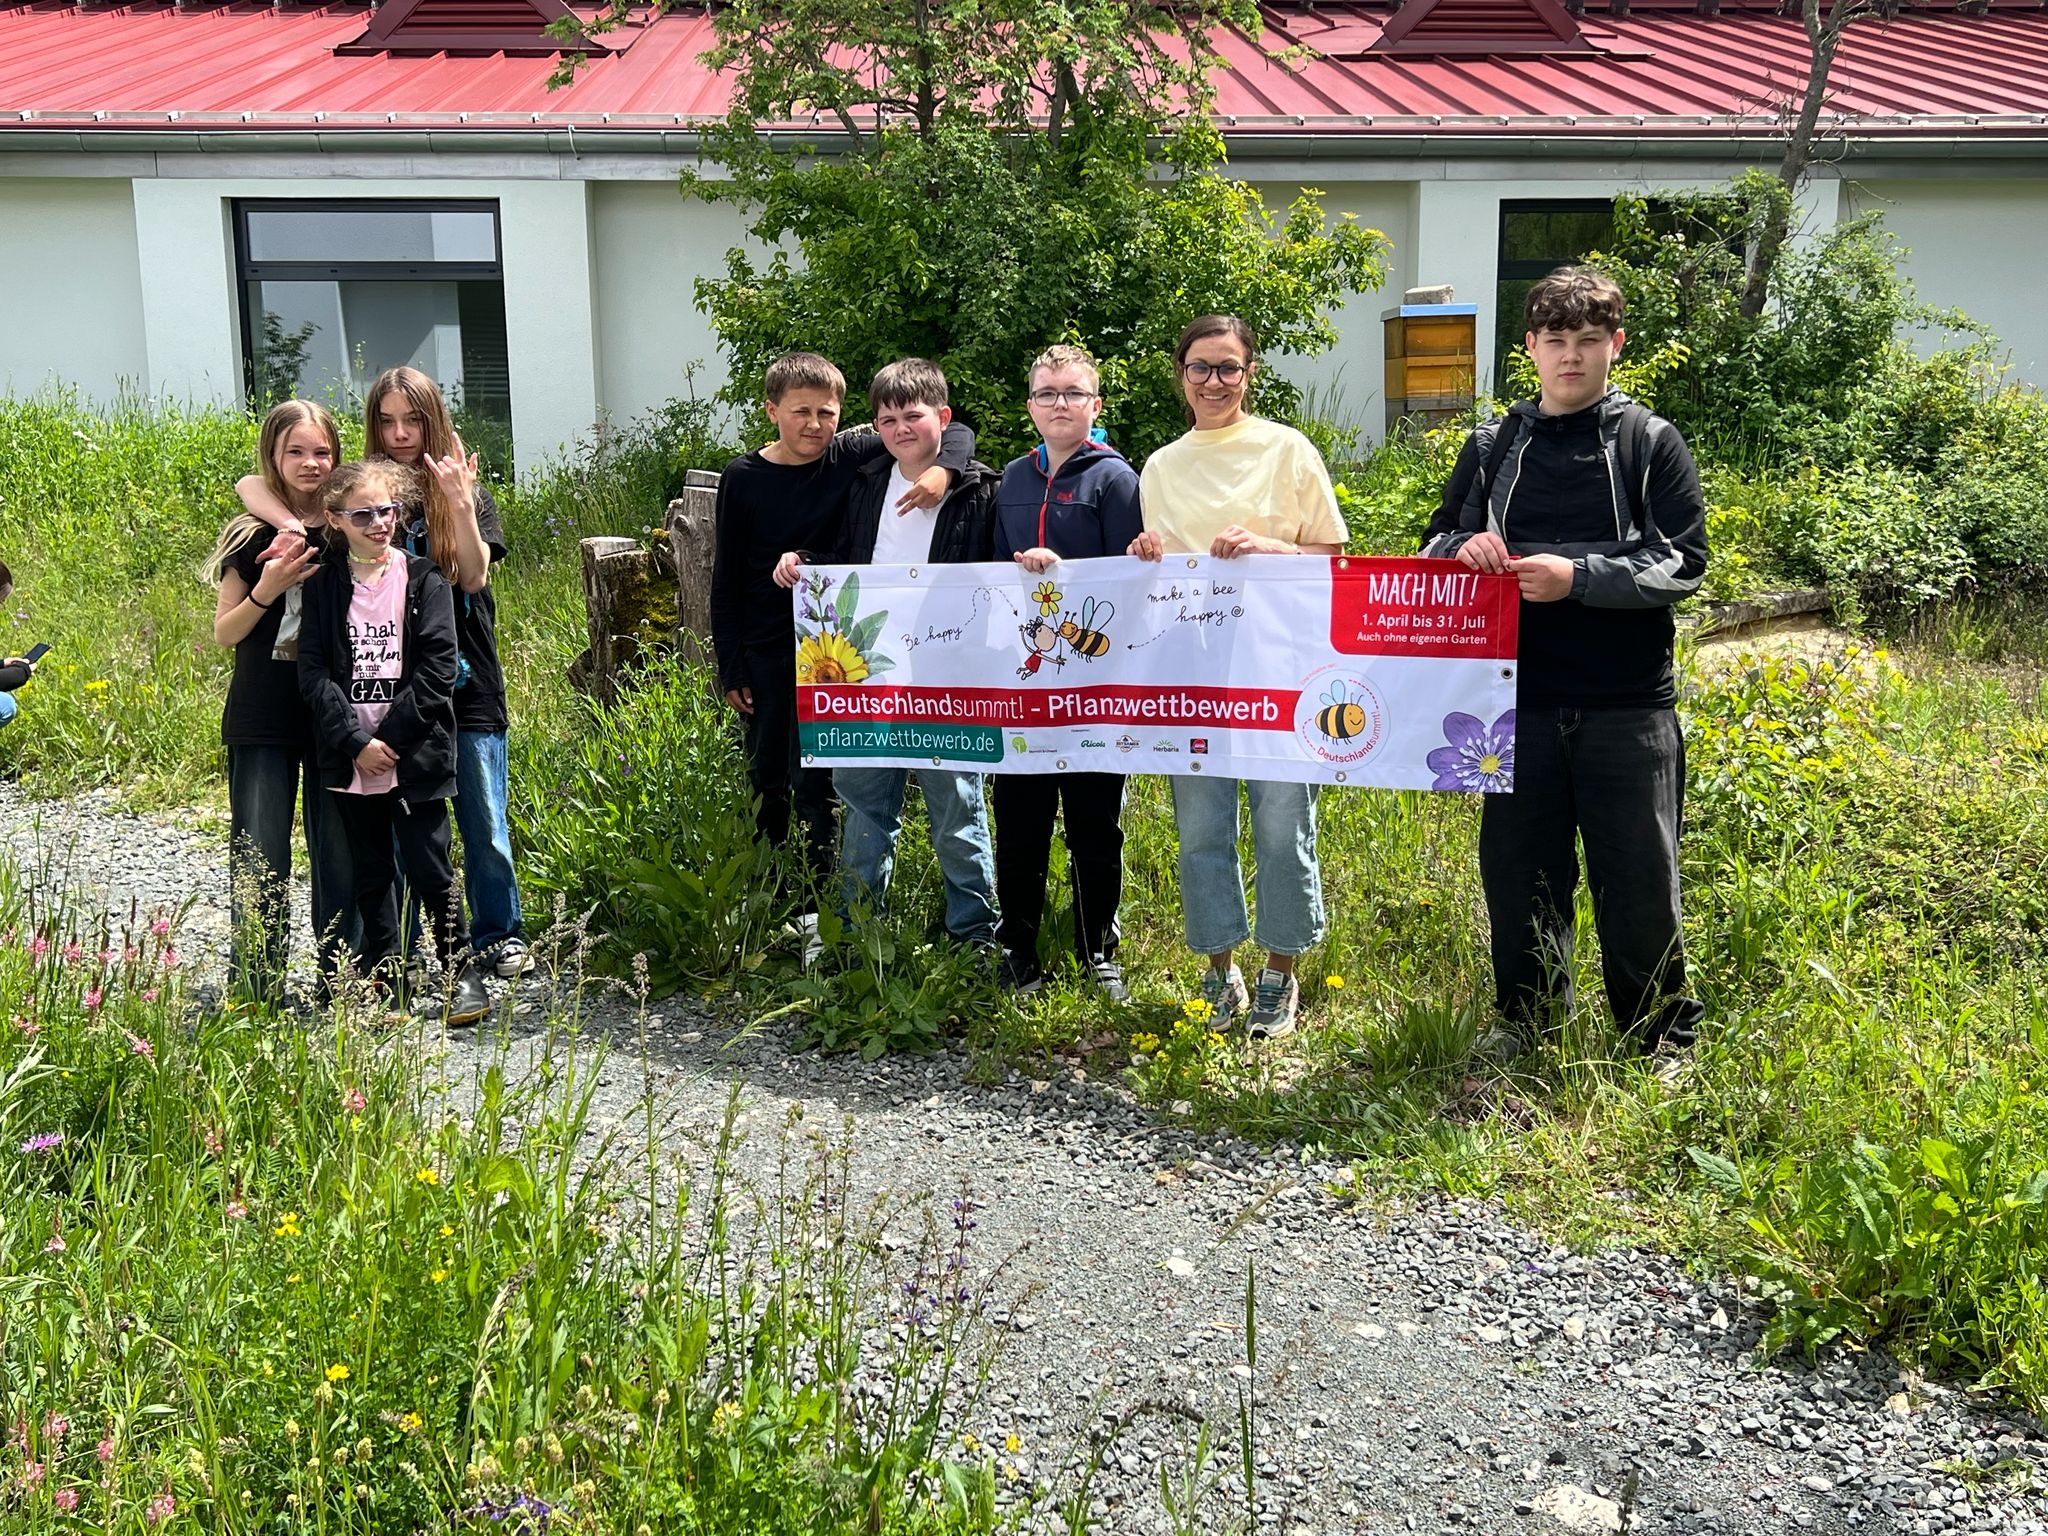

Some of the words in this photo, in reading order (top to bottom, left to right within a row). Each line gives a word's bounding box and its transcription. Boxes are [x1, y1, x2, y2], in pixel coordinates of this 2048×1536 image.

[1147, 585, 1185, 603] make
[1212, 580, 1237, 596] bee
[1368, 572, 1427, 607] MACH
[1431, 573, 1479, 607] MIT!
[1175, 605, 1228, 627] happy
[1362, 613, 1373, 626] 1.
[1376, 613, 1409, 630] April
[1412, 614, 1432, 628] bis
[1436, 615, 1458, 628] 31.
[1461, 615, 1485, 630] Juli
[900, 633, 920, 651] Be
[924, 625, 963, 643] happy
[1356, 631, 1381, 642] Auch
[1383, 632, 1408, 643] ohne
[1409, 633, 1448, 646] eigenen
[1451, 634, 1487, 645] Garten
[352, 645, 402, 664] tanden
[358, 671, 377, 679] nur
[365, 663, 381, 672] mir
[814, 691, 1025, 720] Deutschlandsummt!
[1048, 692, 1279, 721] Pflanzwettbewerb
[817, 728, 995, 752] pflanzwettbewerb.de
[1153, 744, 1180, 753] Herbaria
